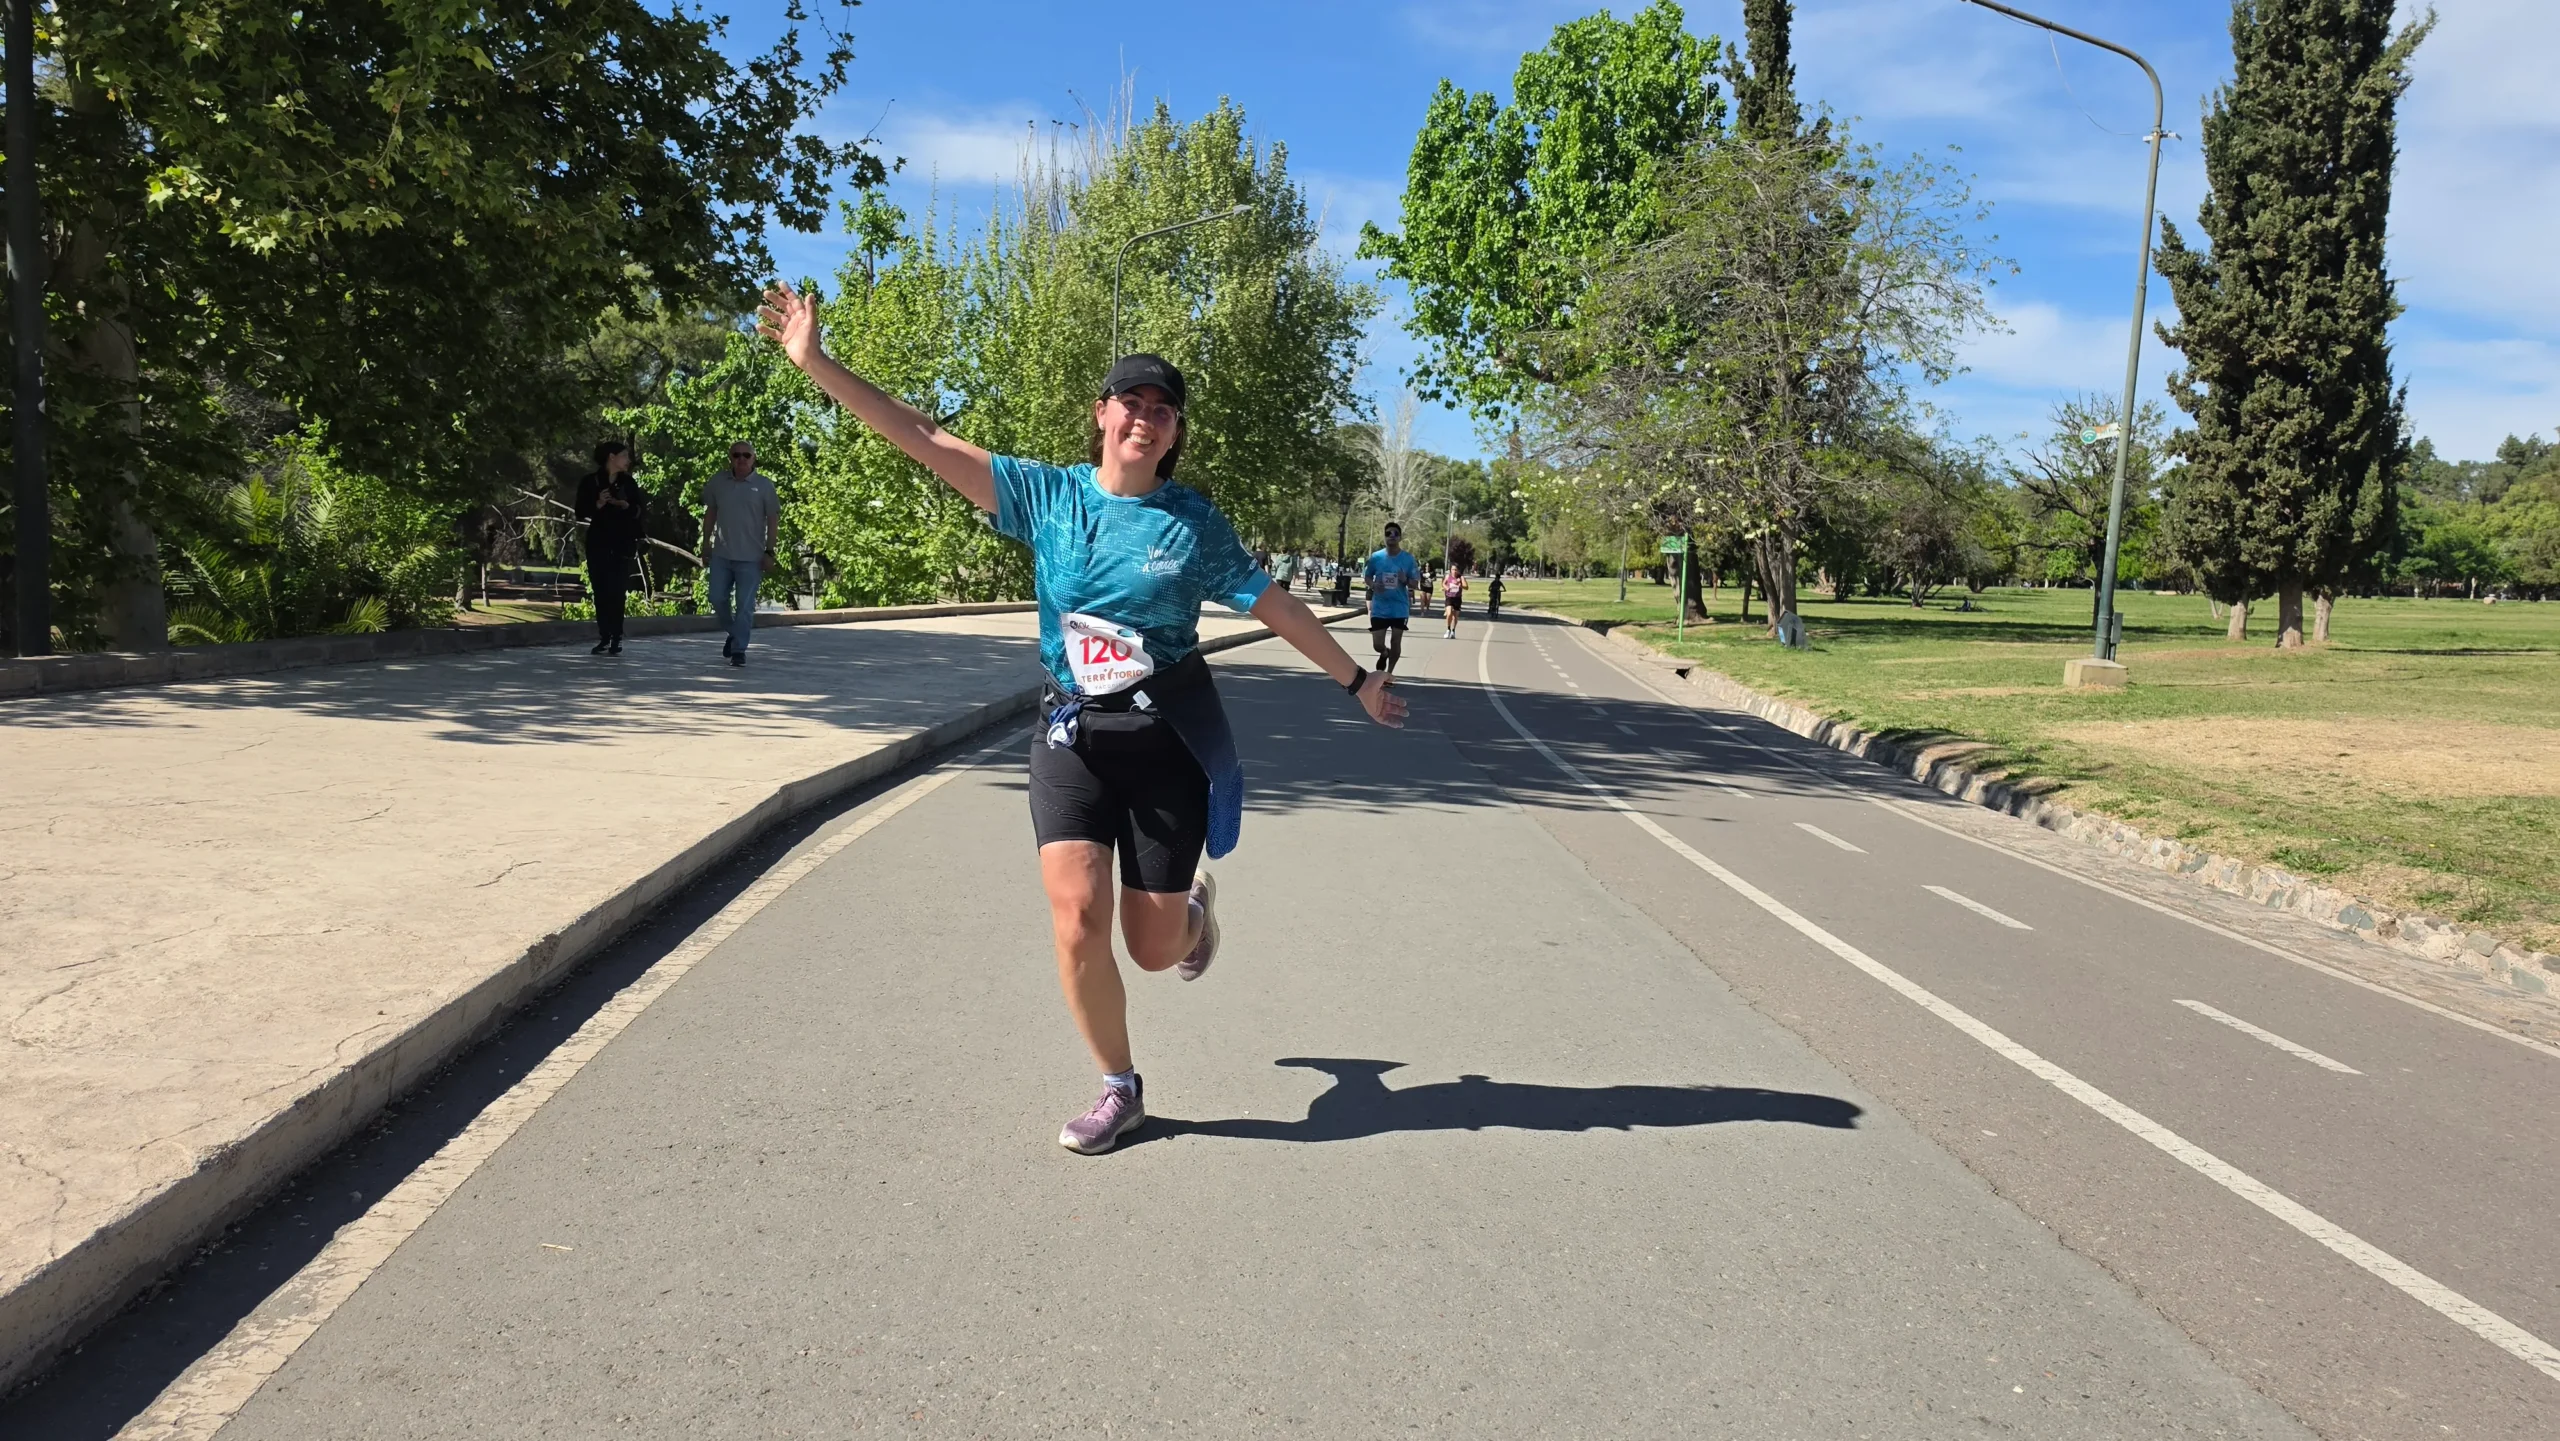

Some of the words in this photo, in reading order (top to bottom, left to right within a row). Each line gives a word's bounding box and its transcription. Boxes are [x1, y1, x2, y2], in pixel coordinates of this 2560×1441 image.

[1142, 562, 1150, 573] a
[1079, 635, 1133, 665] 120
[1081, 668, 1143, 683] TERRITORIO
